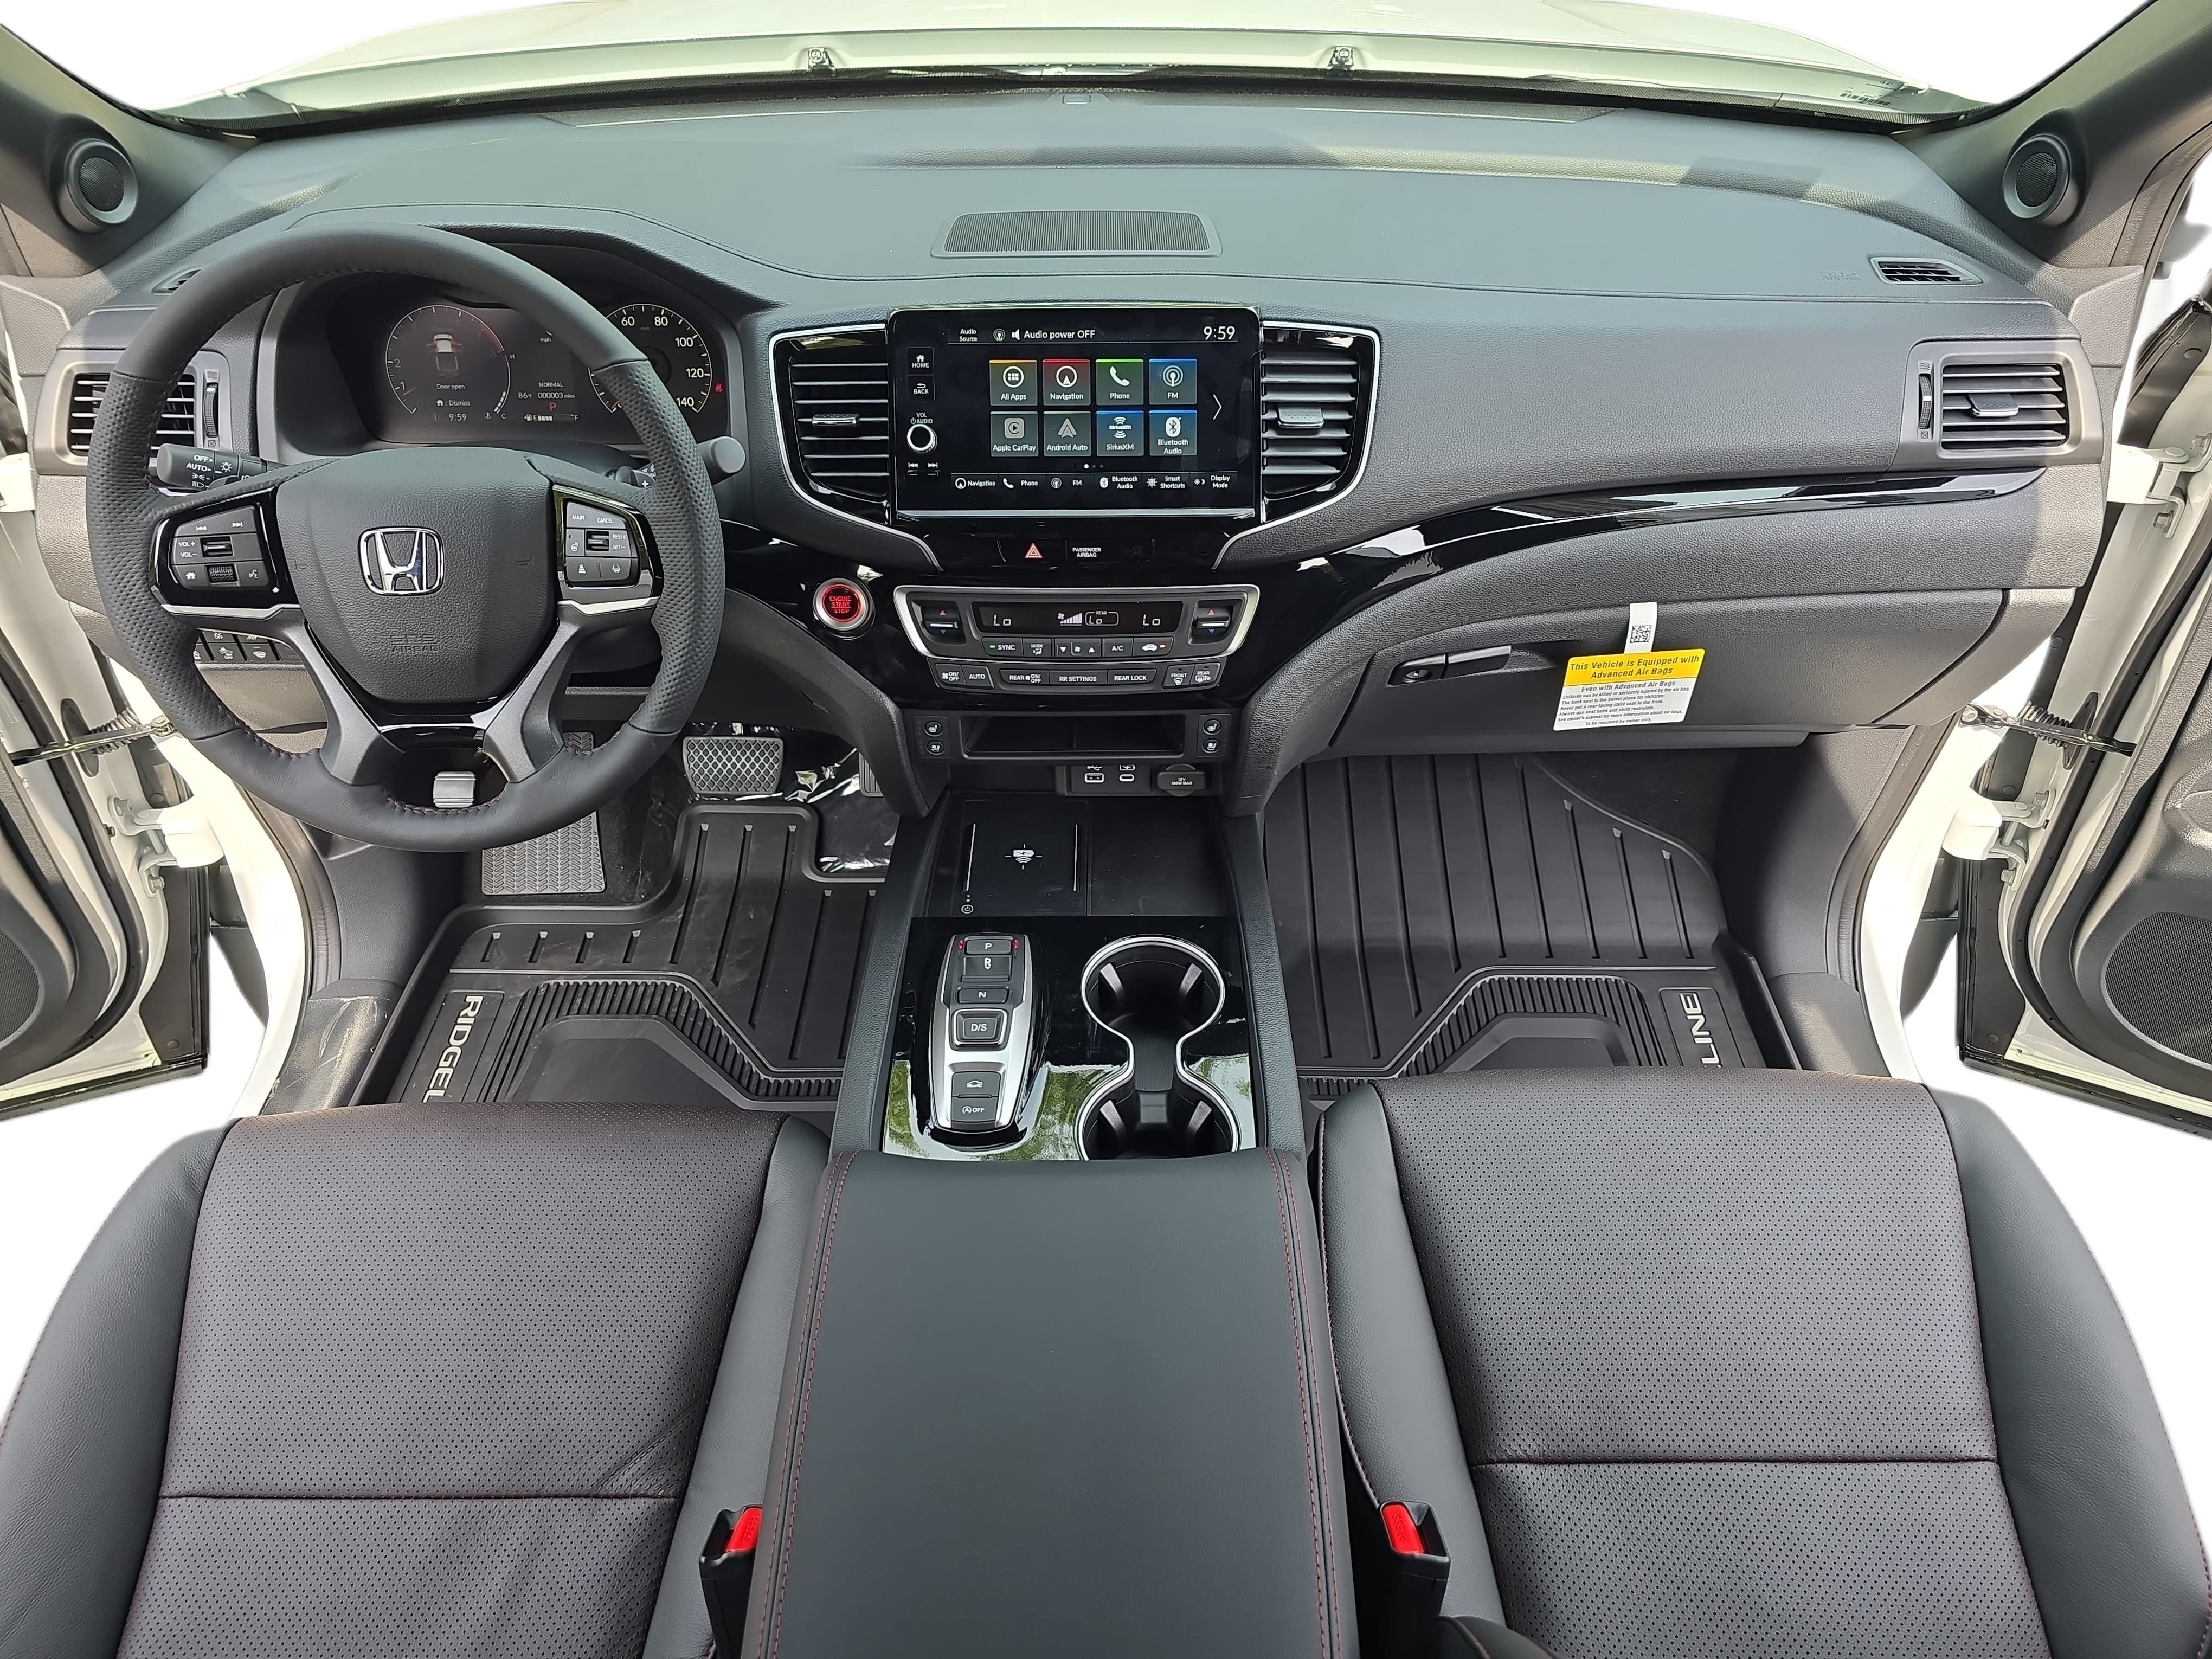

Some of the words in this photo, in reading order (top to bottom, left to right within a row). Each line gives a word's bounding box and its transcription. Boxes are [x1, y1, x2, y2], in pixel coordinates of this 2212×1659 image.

[621, 316, 635, 326] 60
[654, 316, 668, 326] 80
[1024, 330, 1048, 339] Audio
[1050, 331, 1075, 340] power
[1077, 330, 1096, 338] OFF
[1203, 326, 1236, 340] 9:59
[674, 337, 693, 348] 100
[394, 358, 401, 368] 2
[686, 368, 704, 378] 120
[400, 381, 406, 390] 1
[676, 397, 694, 407] 140
[1050, 393, 1084, 401] Navigation
[549, 402, 556, 411] P
[186, 462, 208, 472] AUTO
[993, 614, 1012, 626] Lo
[1143, 614, 1161, 626] Lo
[1592, 660, 1624, 669] Vehicle
[1637, 657, 1679, 667] Equipped
[1681, 655, 1700, 663] with
[1591, 669, 1634, 679] Advanced
[1651, 667, 1673, 676] Bags
[985, 957, 991, 967] R
[971, 1023, 987, 1032] D/S
[1679, 993, 1722, 1068] LINE
